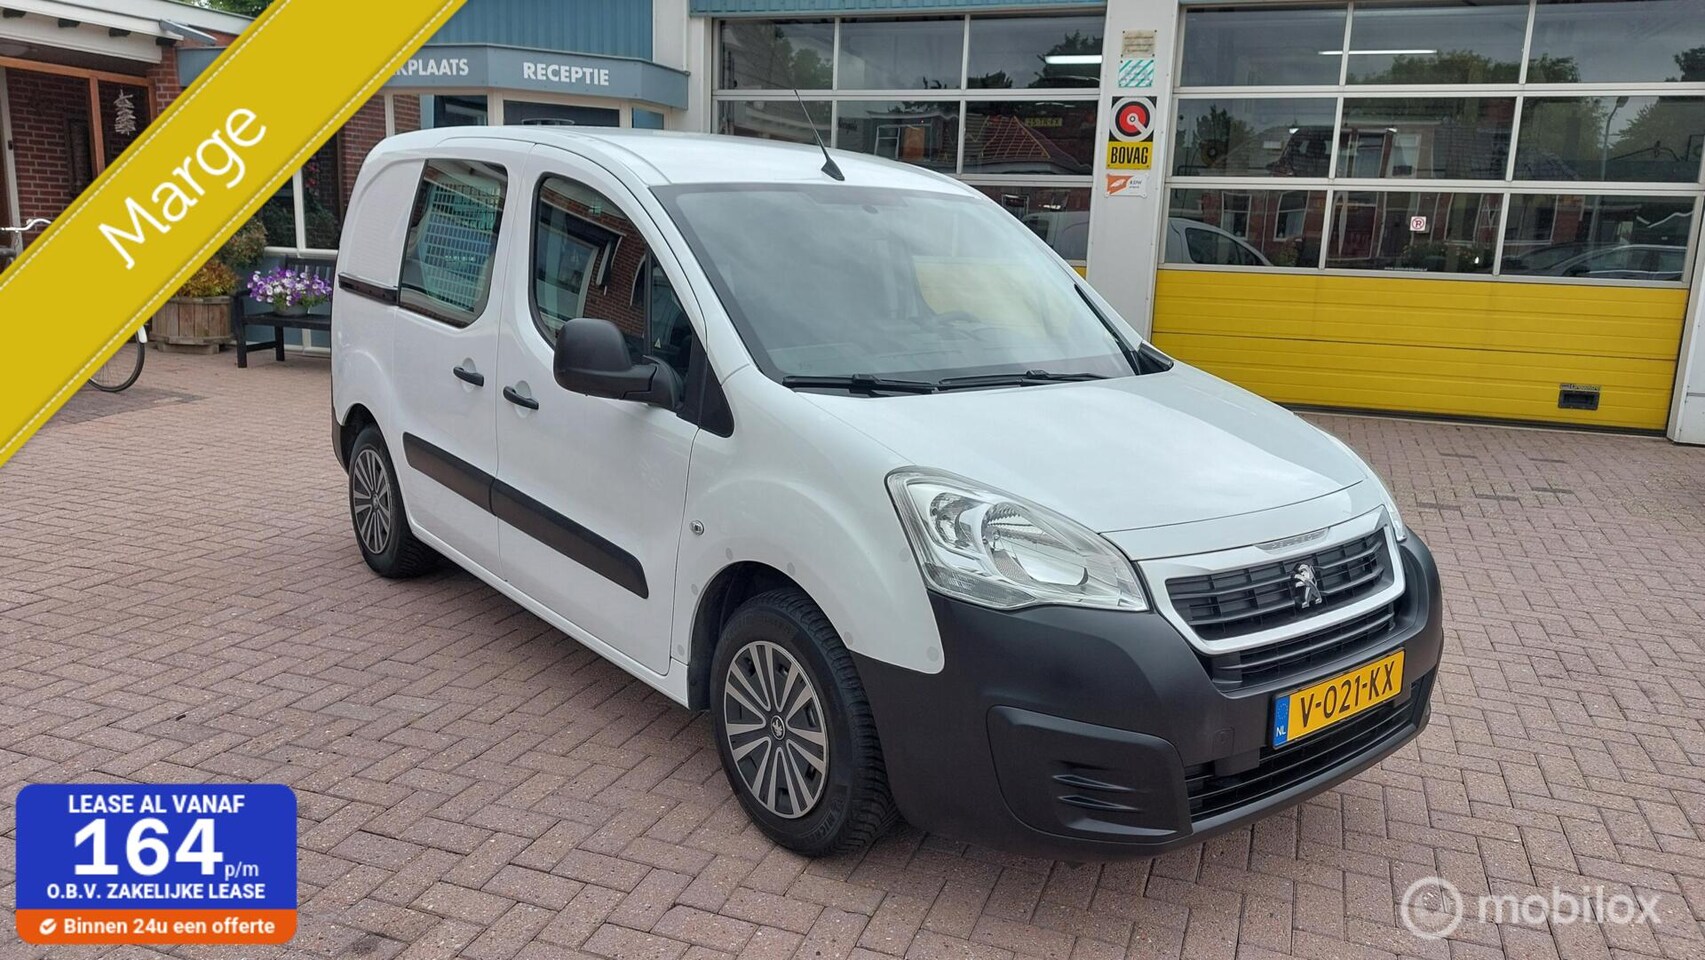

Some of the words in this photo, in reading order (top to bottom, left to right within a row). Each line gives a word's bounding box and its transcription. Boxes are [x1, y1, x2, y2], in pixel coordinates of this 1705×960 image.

[395, 58, 469, 76] KPLAATS
[522, 61, 610, 85] RECEPTIE
[1110, 146, 1149, 165] BOVAG
[1300, 660, 1395, 728] V-021-KX
[1276, 725, 1287, 737] NL
